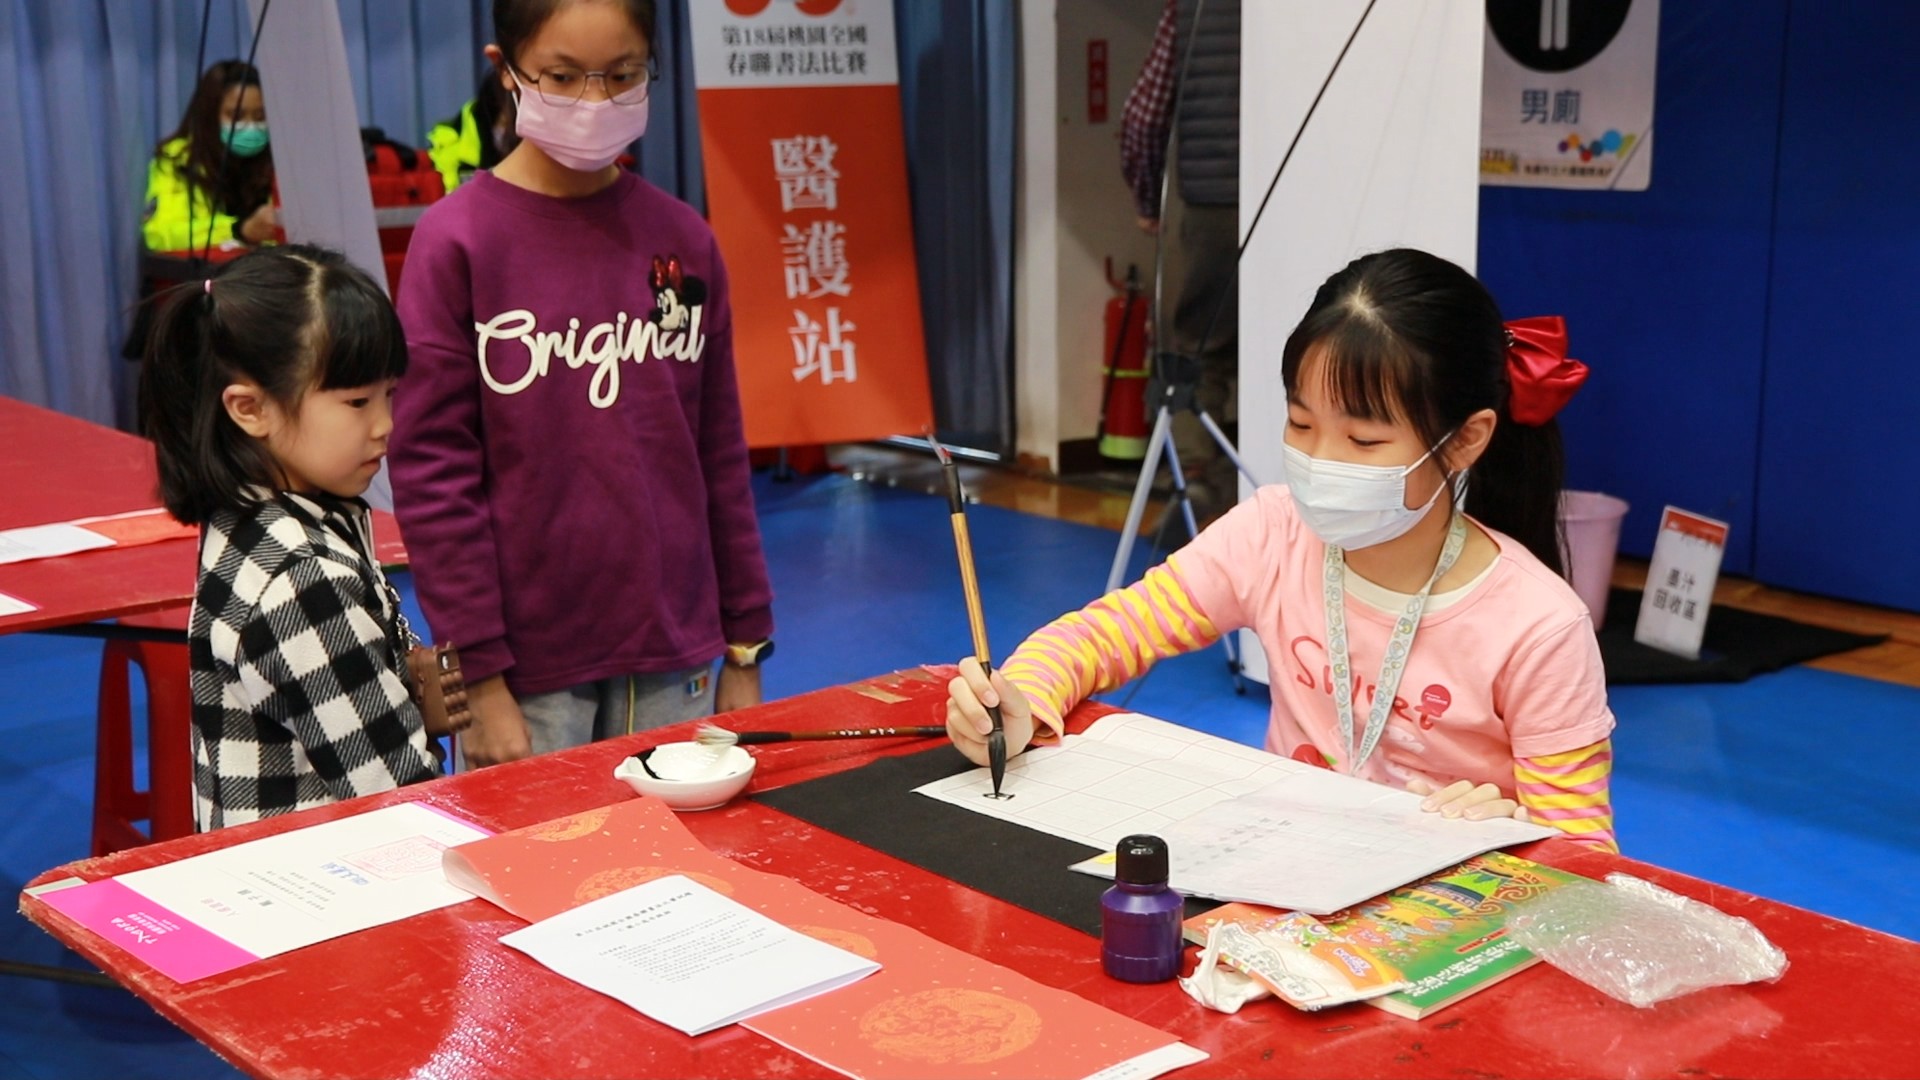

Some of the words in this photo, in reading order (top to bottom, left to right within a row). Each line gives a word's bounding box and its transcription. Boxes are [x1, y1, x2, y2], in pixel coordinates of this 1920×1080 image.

[1521, 89, 1581, 124] 男廁
[770, 135, 857, 385] 醫護站
[475, 308, 705, 408] Original
[1668, 567, 1695, 592] 墨汁
[1653, 588, 1697, 621] 回收區
